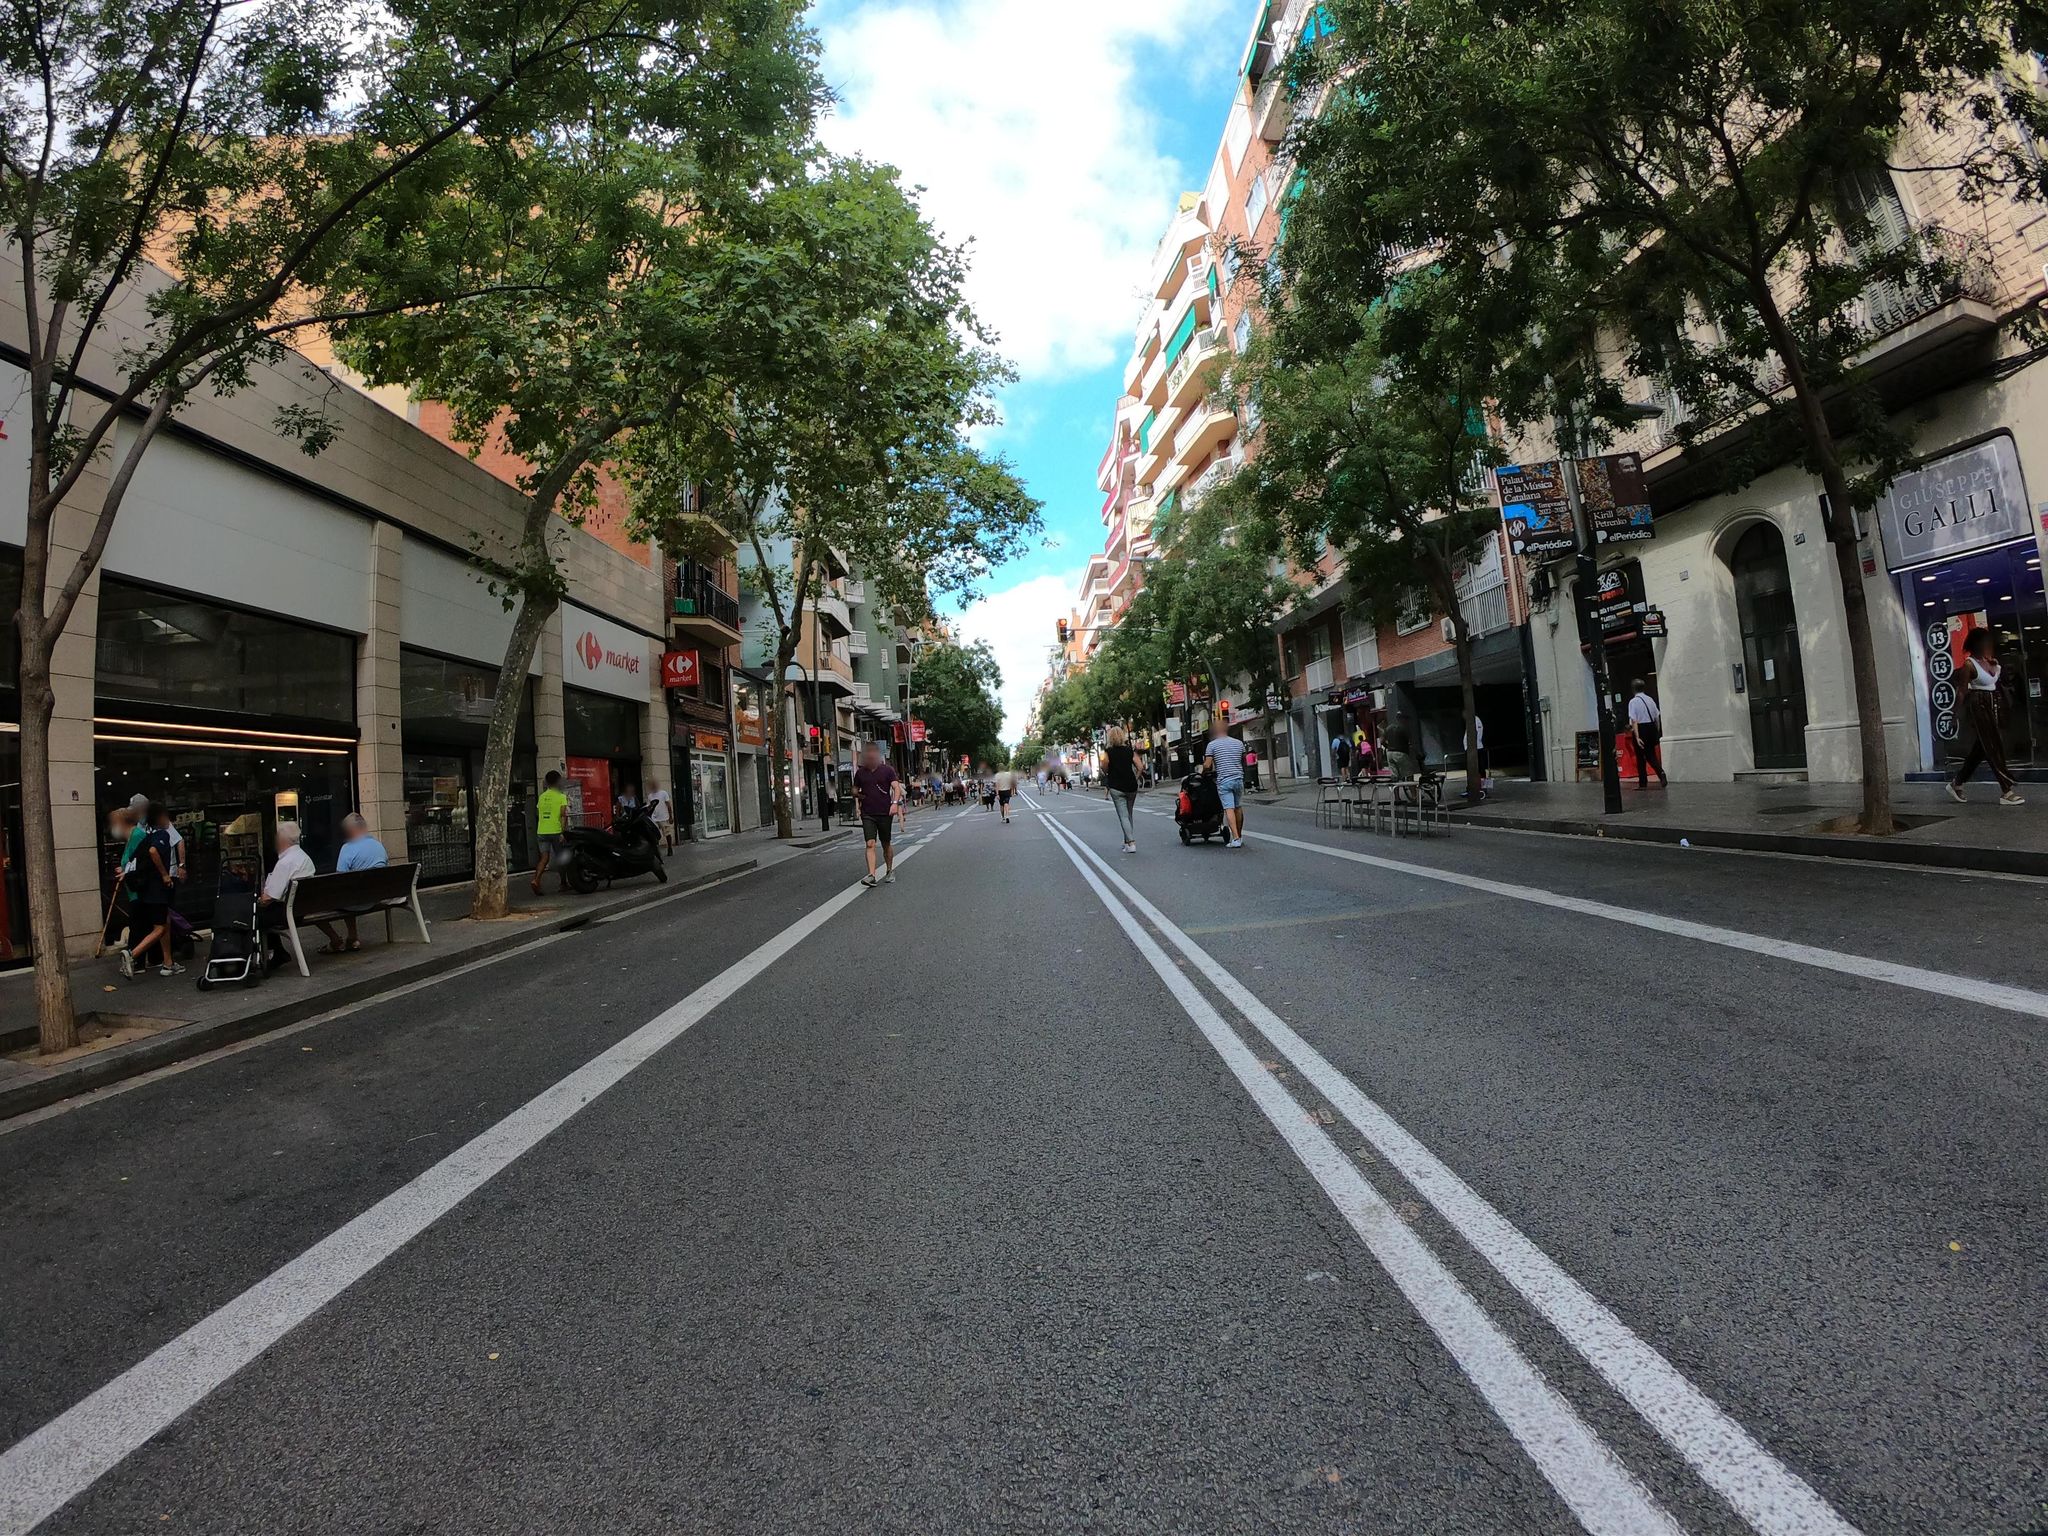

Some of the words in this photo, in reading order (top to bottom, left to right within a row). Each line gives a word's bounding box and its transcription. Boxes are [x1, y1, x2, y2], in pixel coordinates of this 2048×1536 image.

[1501, 477, 1523, 486] Palau
[1503, 486, 1513, 495] de
[1514, 484, 1522, 493] la
[1523, 480, 1553, 492] Música
[1900, 467, 1993, 509] GIUSEPPE
[1504, 492, 1541, 503] Catalana
[1594, 511, 1614, 520] Kirill
[1904, 487, 2000, 538] GALLI
[1595, 518, 1627, 528] Petrenko
[1609, 529, 1652, 543] elPeriódico
[1526, 539, 1573, 553] elPeriódico
[605, 649, 640, 675] market
[669, 674, 693, 683] market
